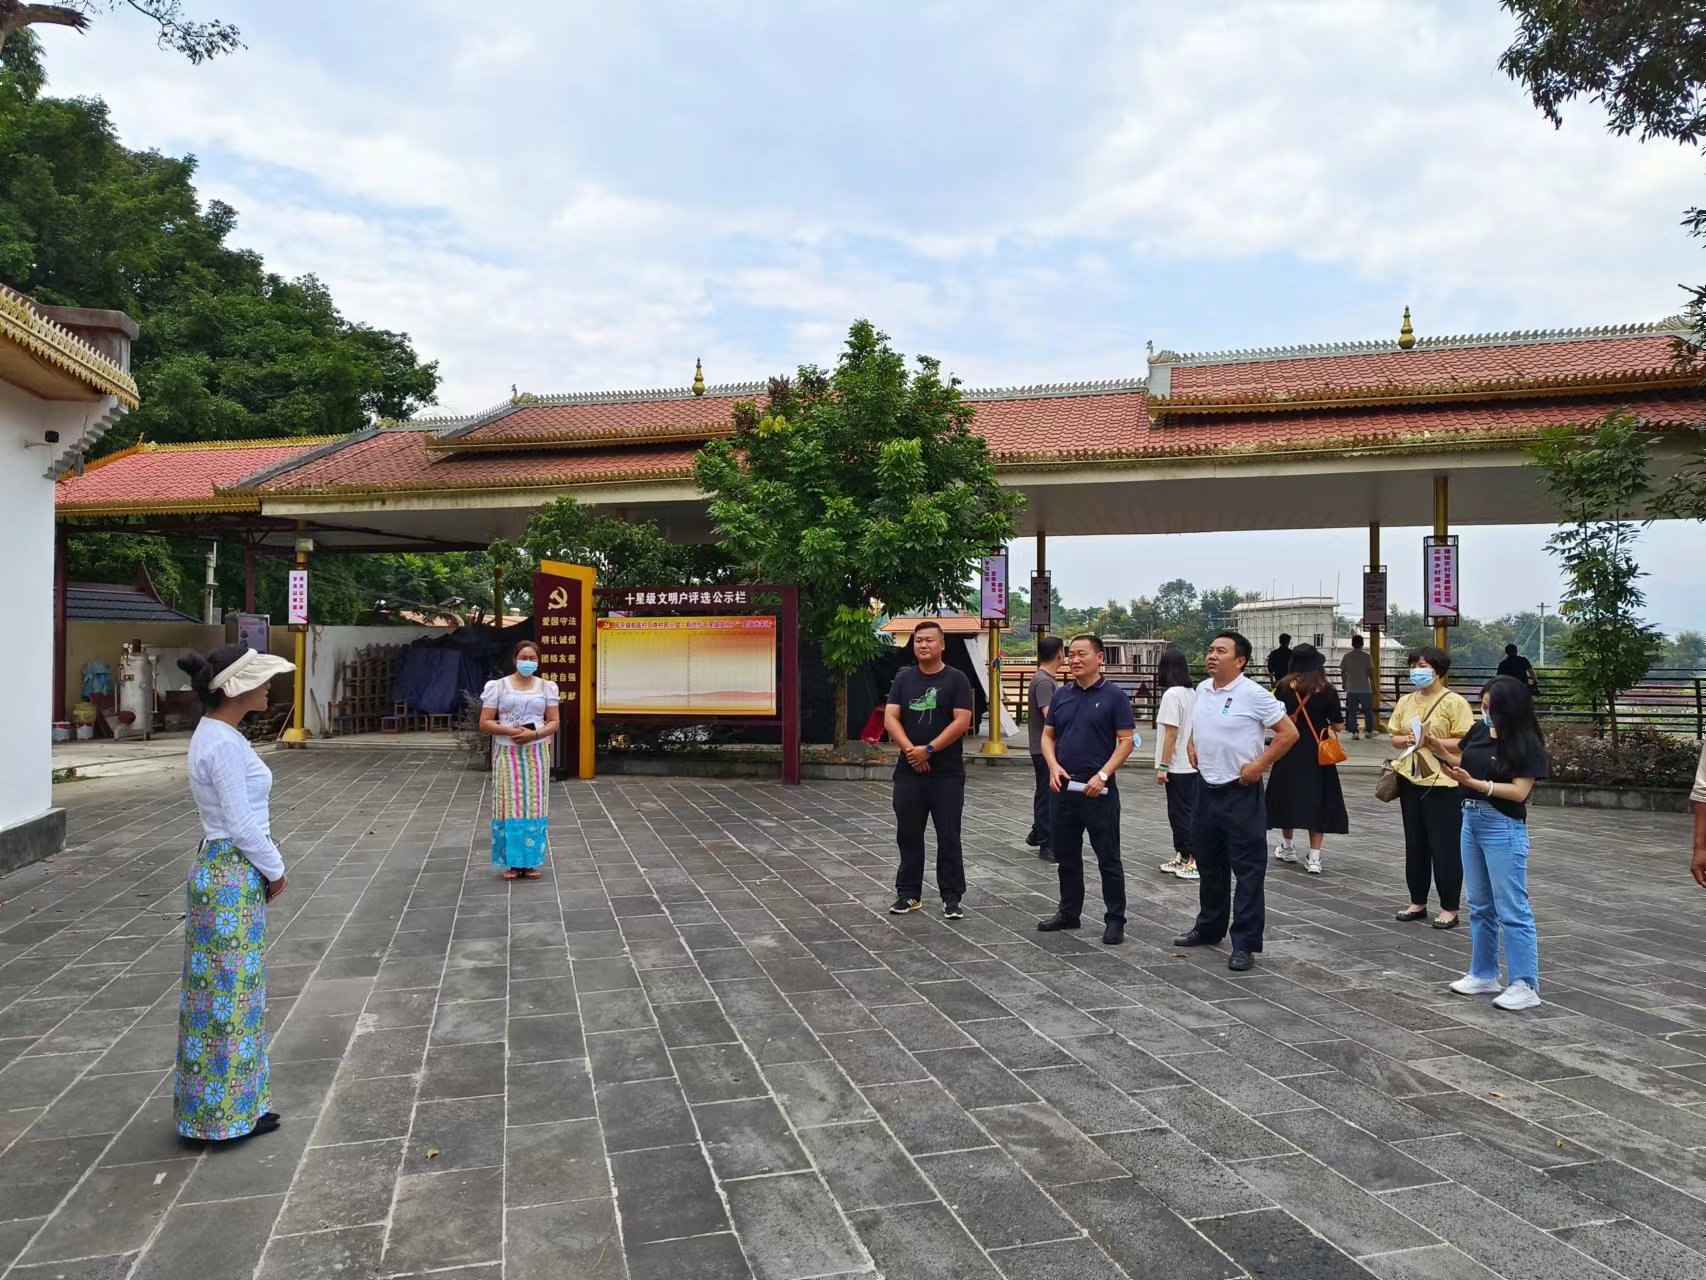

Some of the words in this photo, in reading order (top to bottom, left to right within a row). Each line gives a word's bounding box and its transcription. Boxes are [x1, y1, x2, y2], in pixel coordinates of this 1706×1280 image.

[625, 591, 746, 605] 十星级文明户评选公示栏
[542, 617, 577, 626] 爱国守法
[541, 636, 576, 645] 明礼诚信
[541, 654, 576, 663] 团结友善
